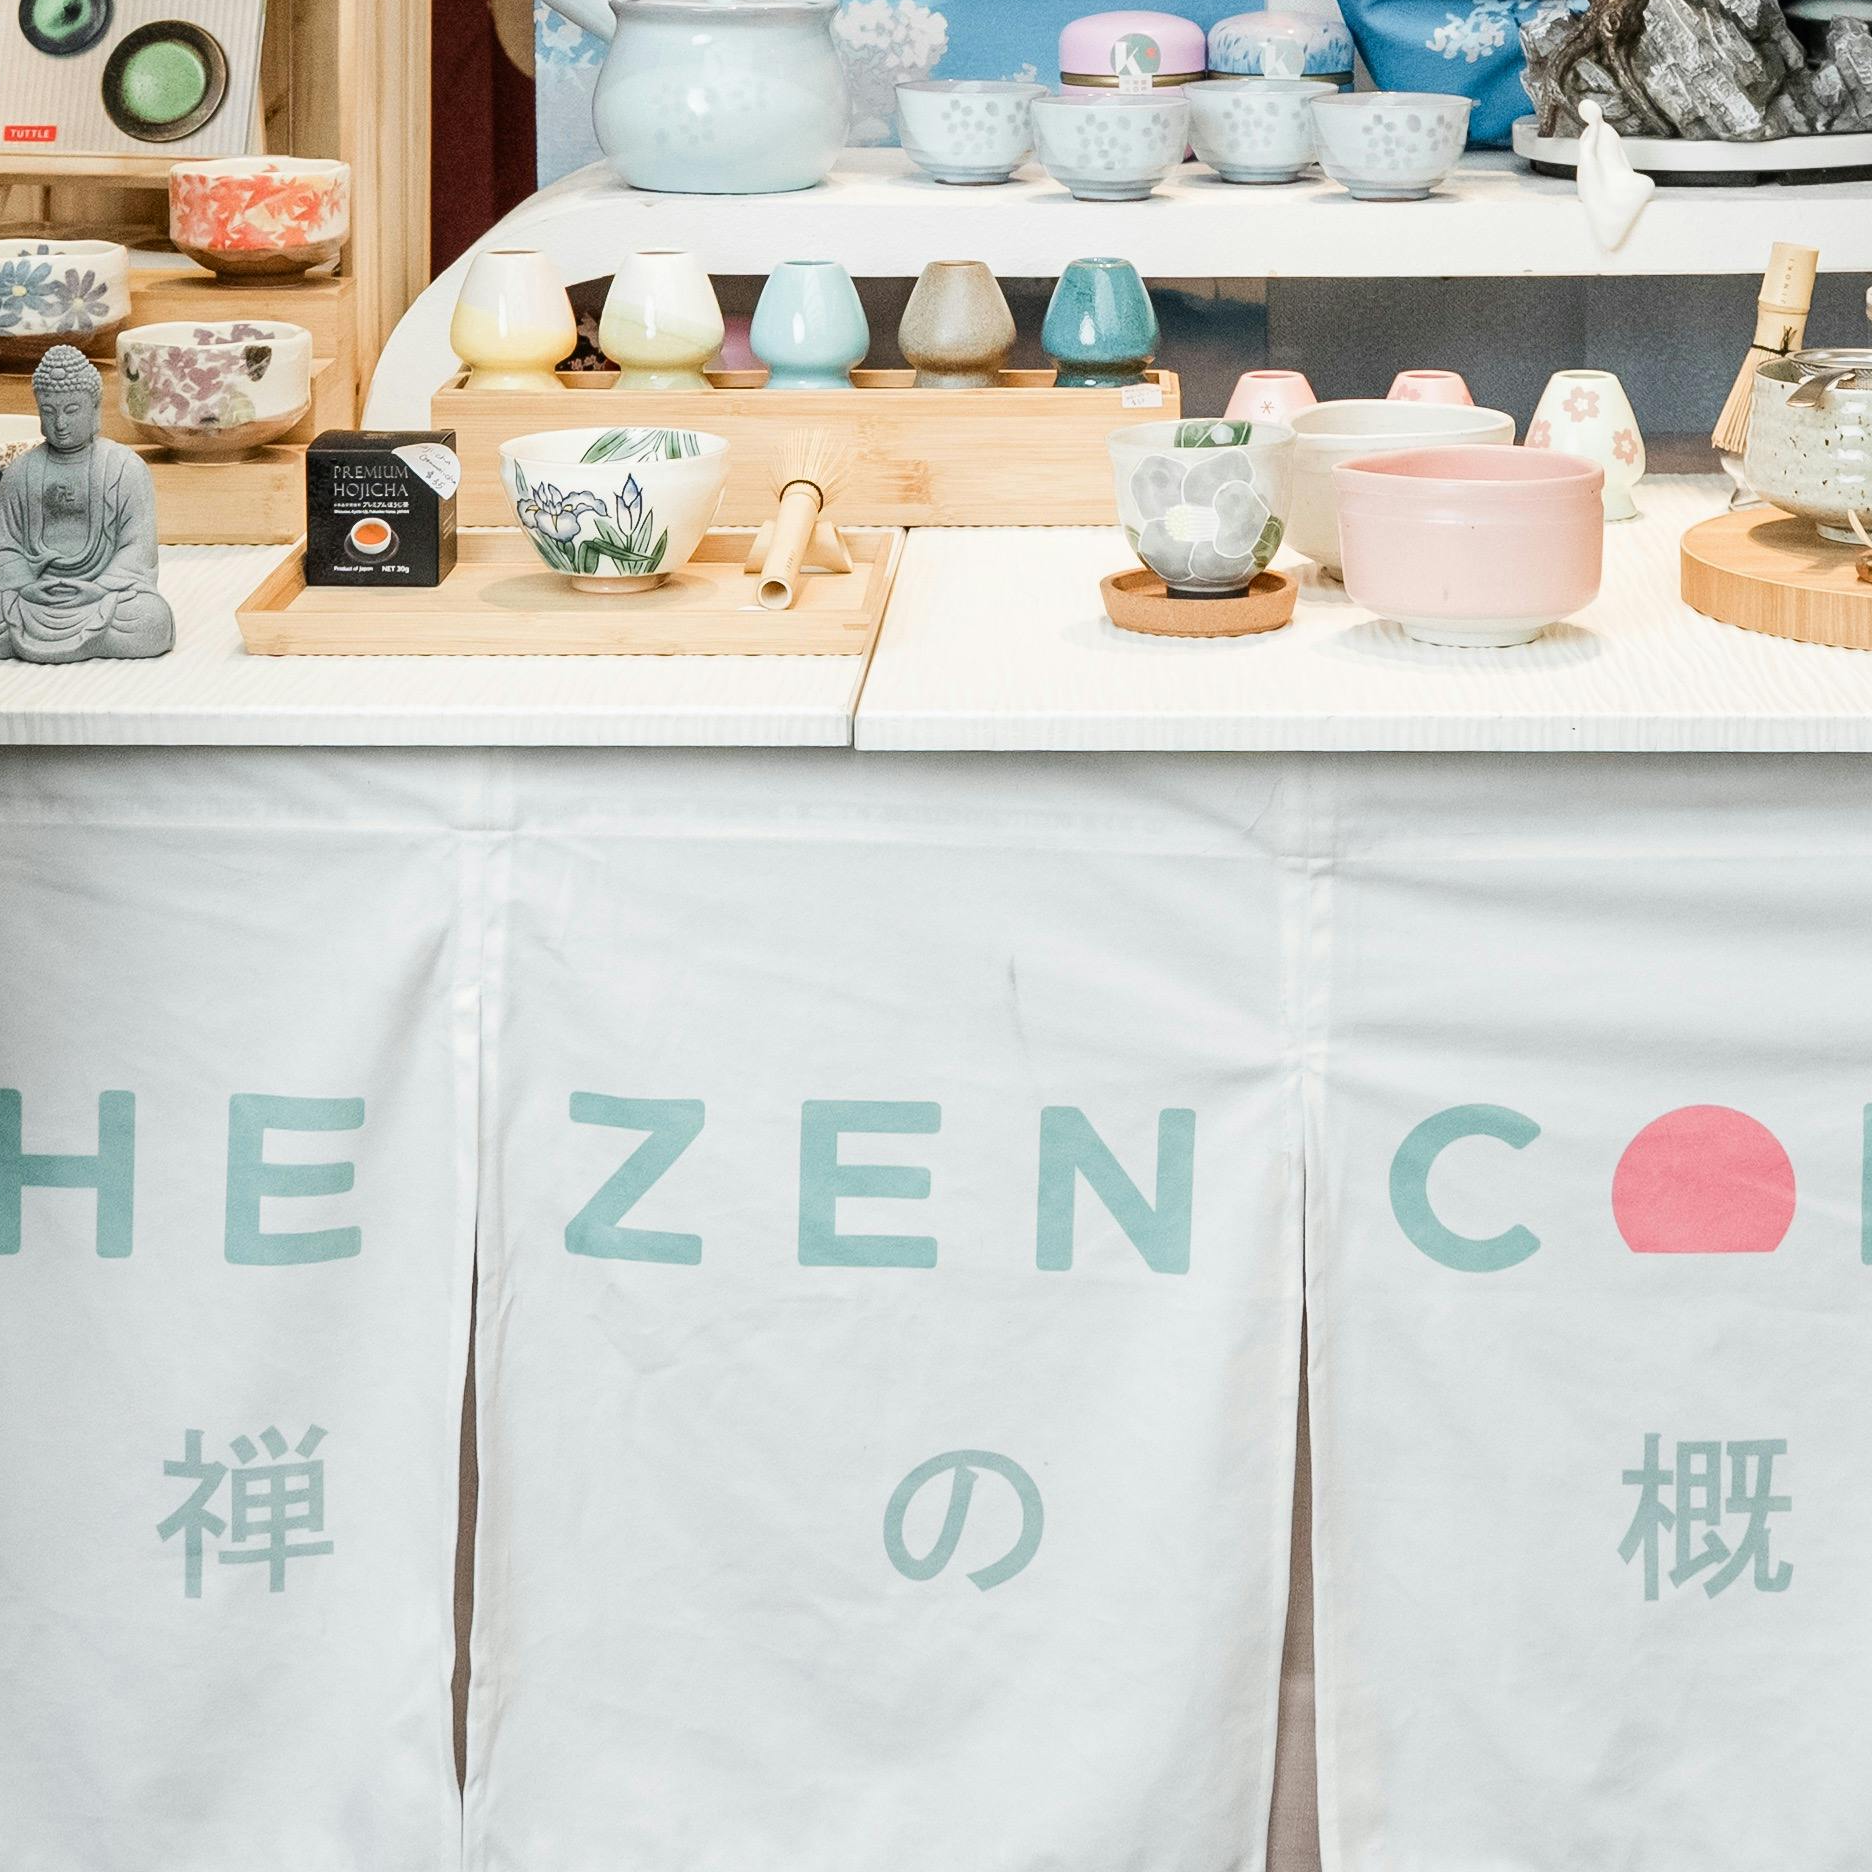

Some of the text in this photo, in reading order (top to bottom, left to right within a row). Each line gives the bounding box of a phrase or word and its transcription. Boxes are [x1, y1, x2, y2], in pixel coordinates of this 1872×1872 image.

[10, 129, 50, 138] TUTTLE
[334, 465, 408, 479] PREMIUM
[334, 482, 409, 500] HOJICHA
[396, 565, 409, 574] 30g
[564, 1090, 1198, 1276] ZEN
